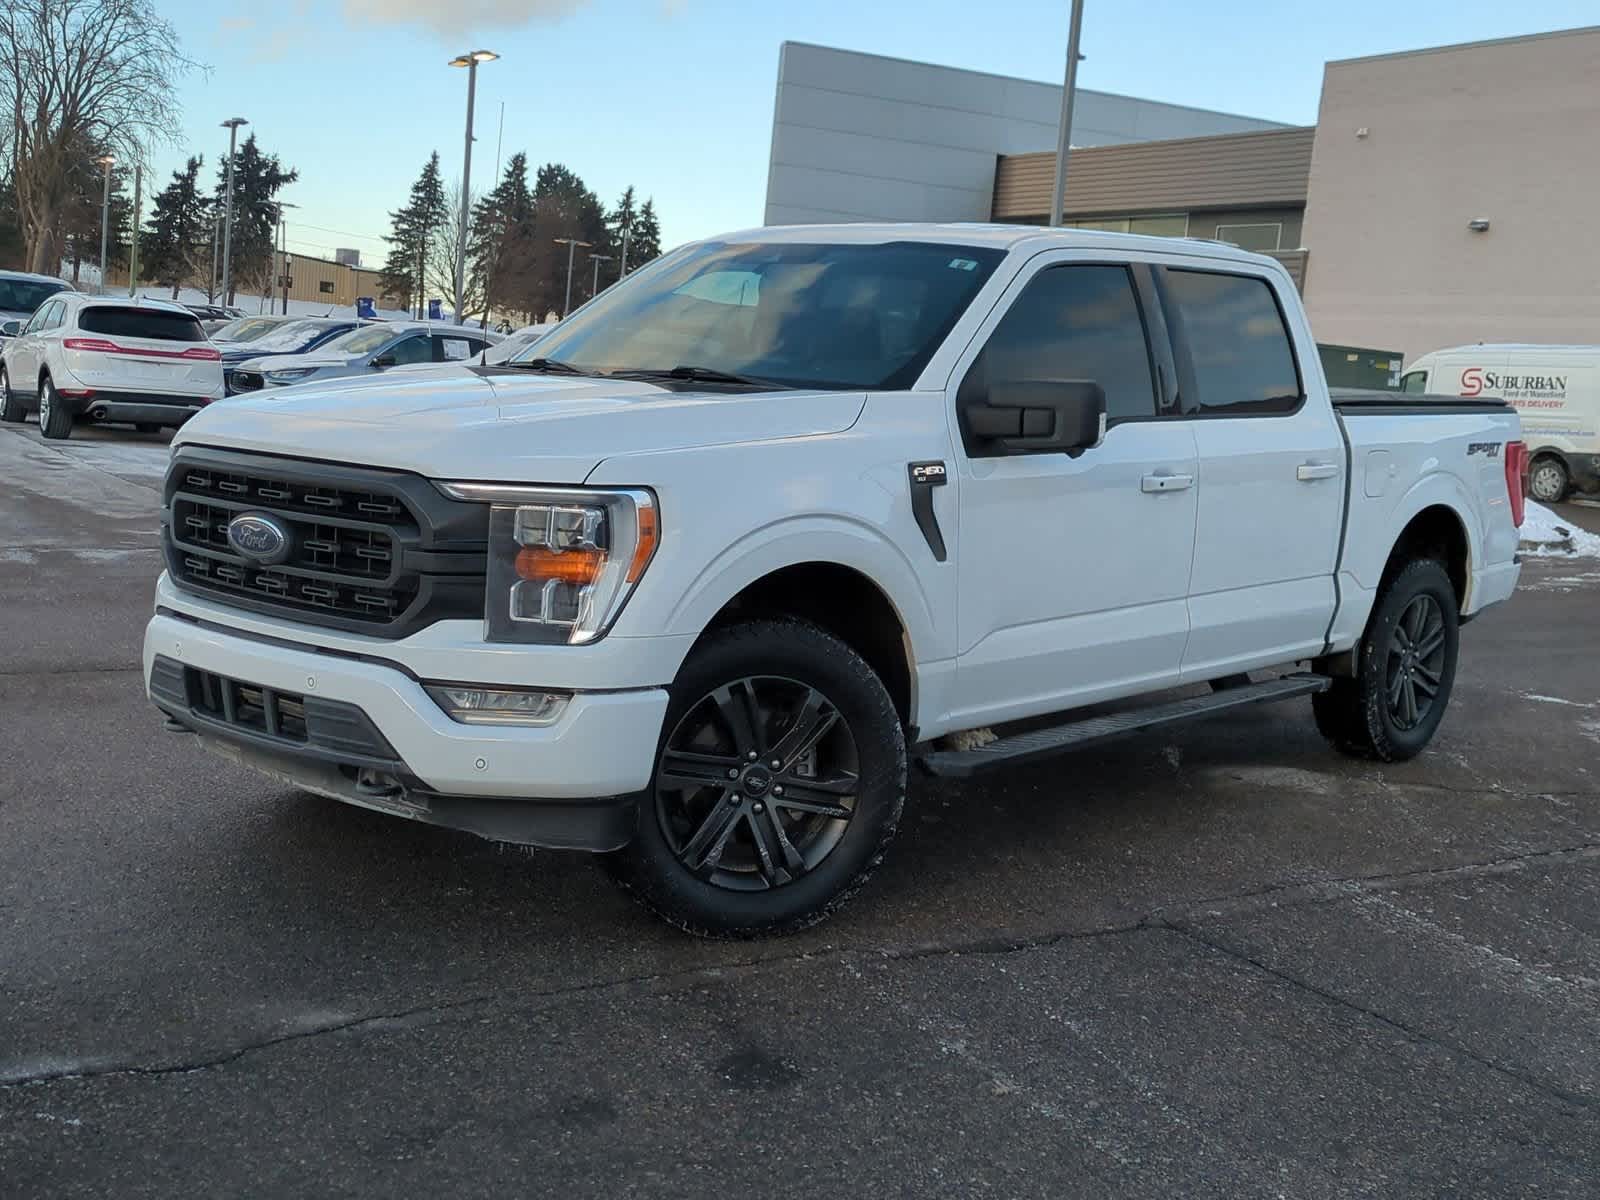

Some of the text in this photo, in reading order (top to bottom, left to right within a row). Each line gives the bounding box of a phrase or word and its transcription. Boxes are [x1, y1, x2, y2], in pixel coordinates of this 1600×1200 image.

[1484, 372, 1567, 390] SUBURBAN
[1503, 390, 1519, 398] Ford
[1527, 400, 1565, 409] DELIVERY
[239, 524, 268, 549] Ford
